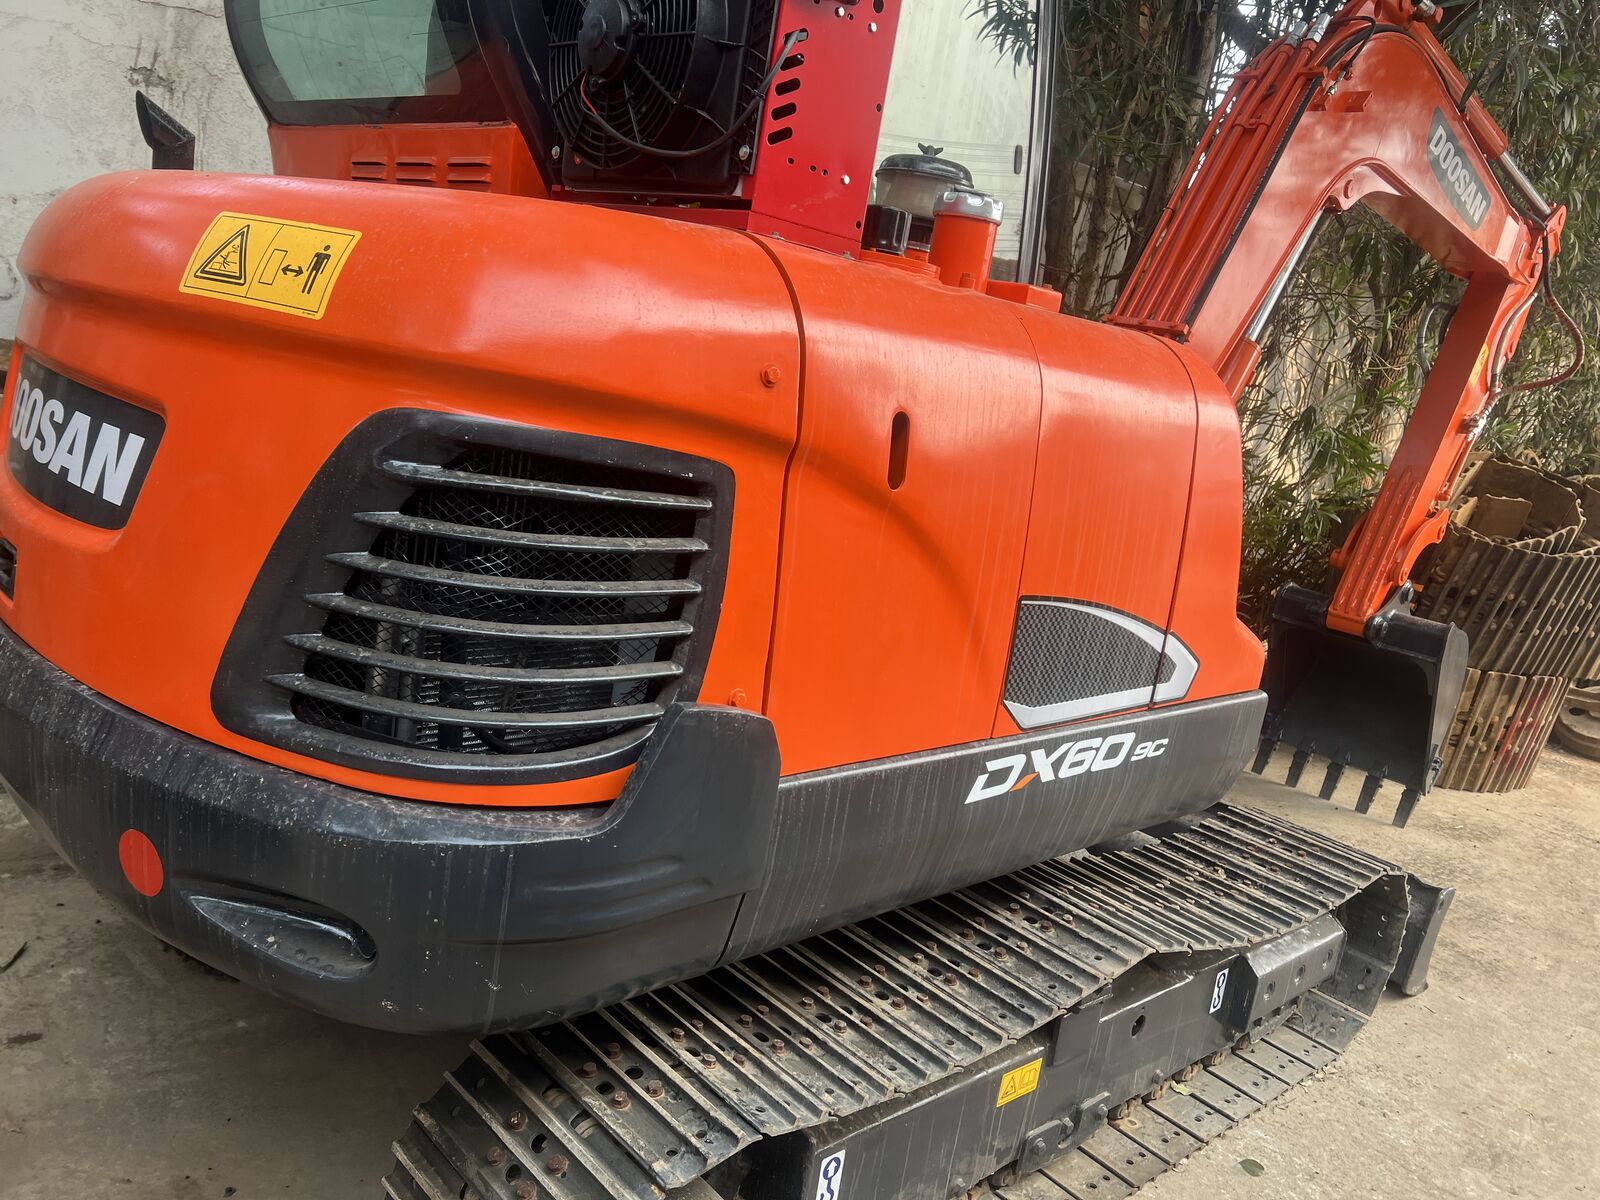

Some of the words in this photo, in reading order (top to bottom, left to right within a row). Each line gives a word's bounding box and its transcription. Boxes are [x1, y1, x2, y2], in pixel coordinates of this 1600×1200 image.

[1429, 125, 1487, 223] DOOSAN
[9, 373, 146, 506] OOSAN
[964, 732, 1136, 805] DX60
